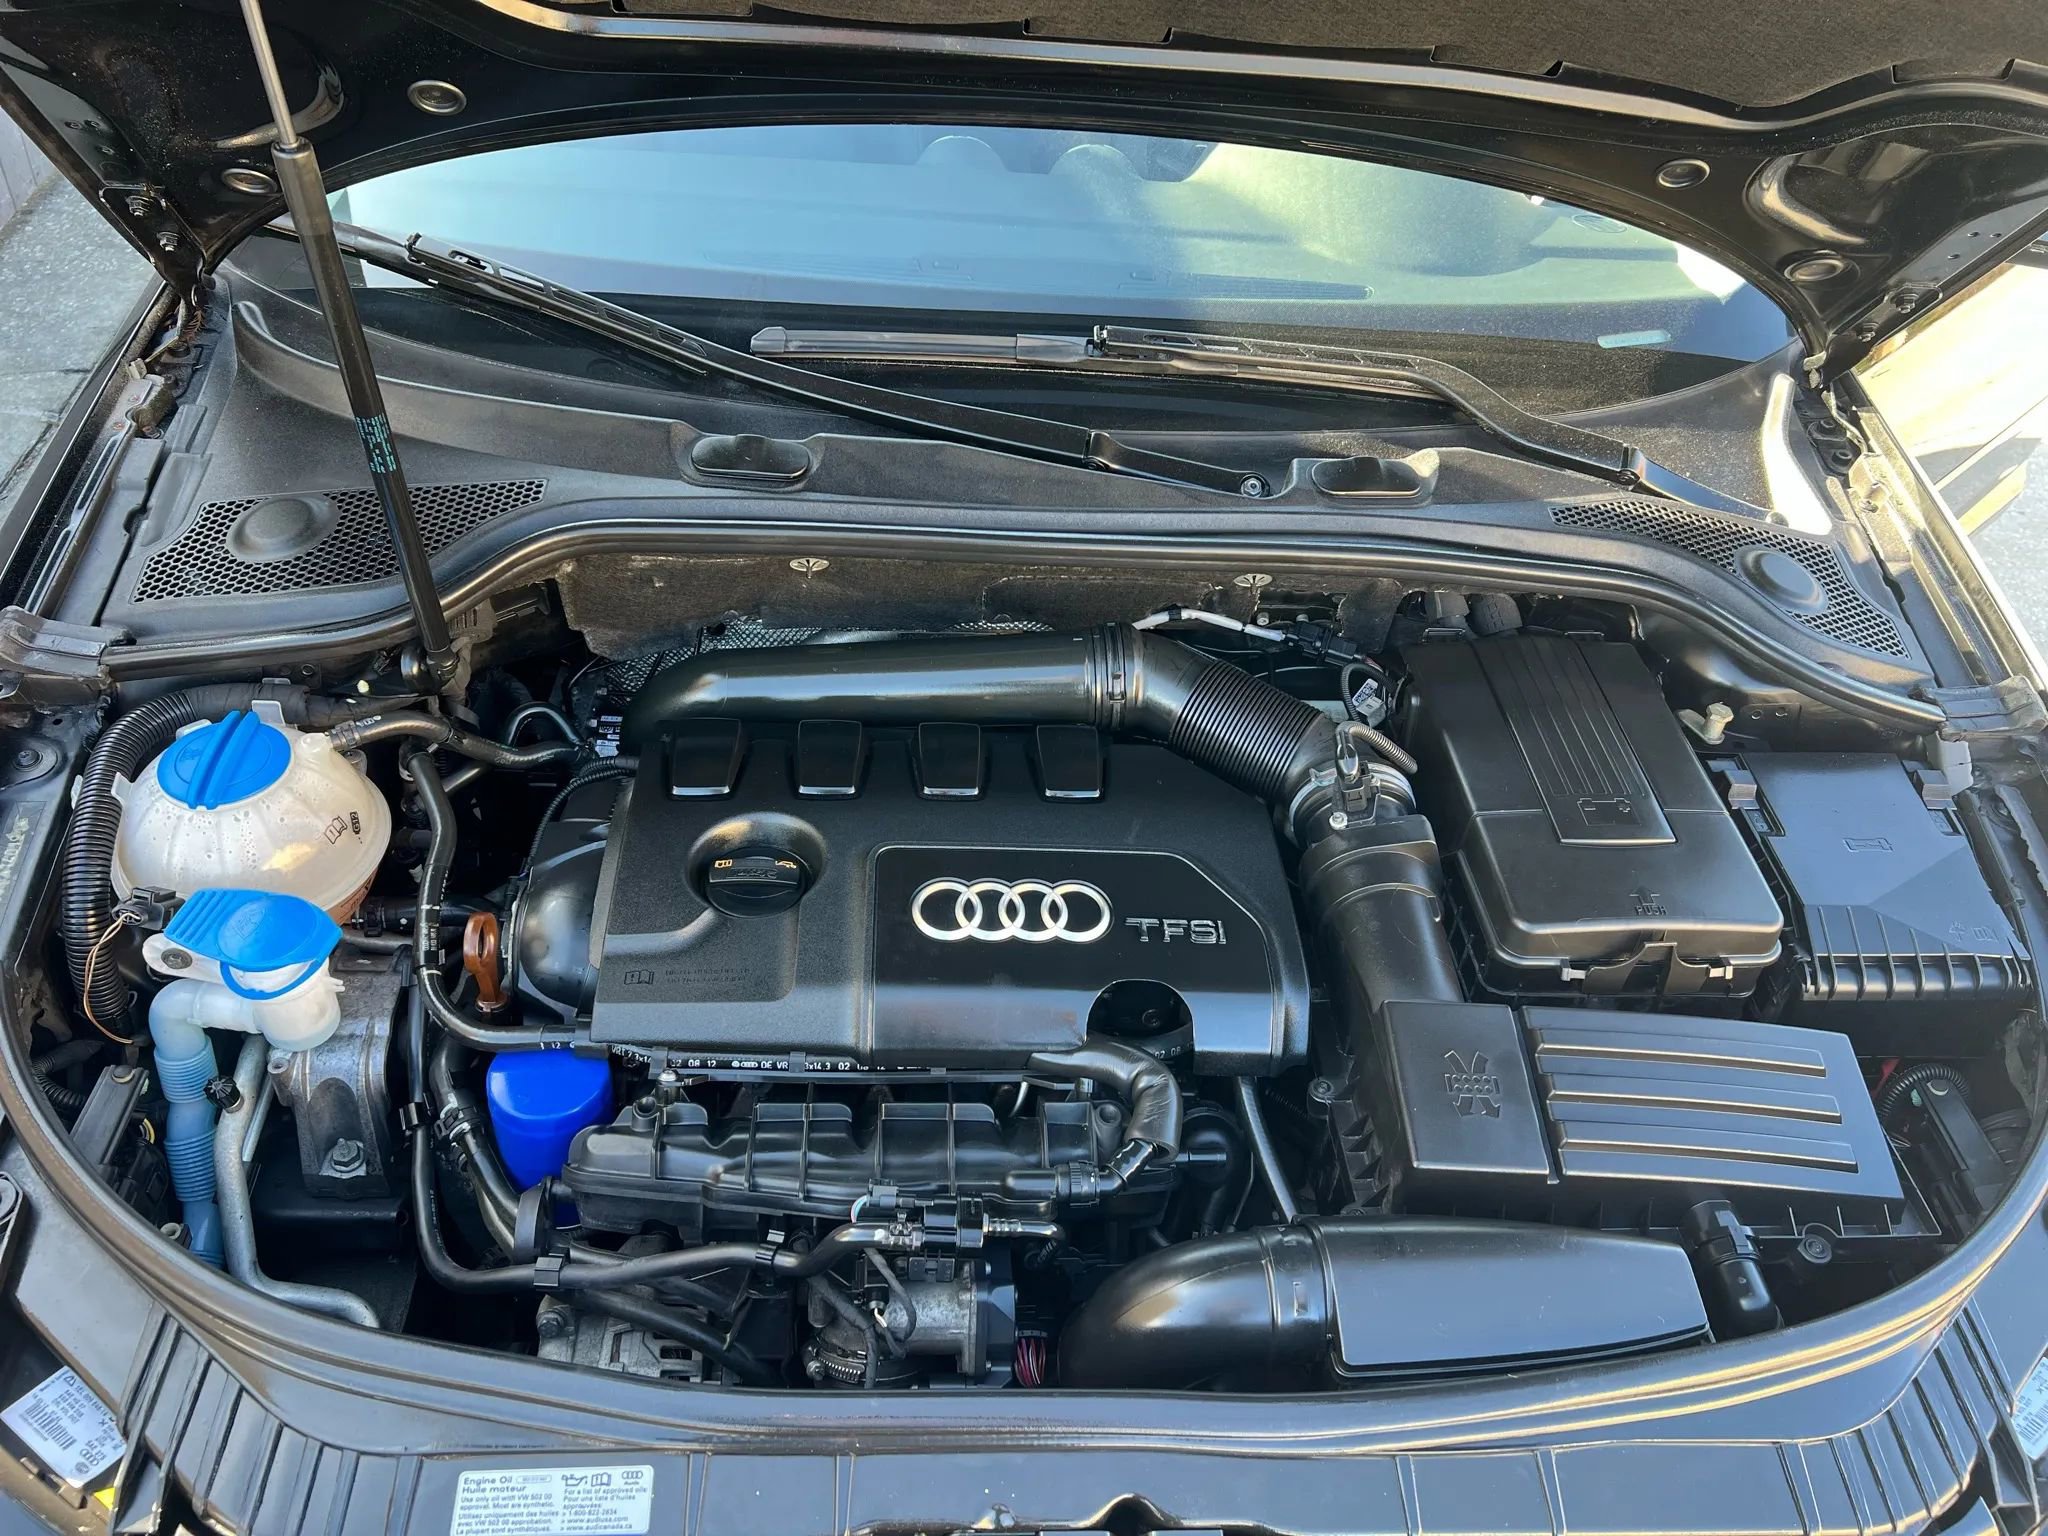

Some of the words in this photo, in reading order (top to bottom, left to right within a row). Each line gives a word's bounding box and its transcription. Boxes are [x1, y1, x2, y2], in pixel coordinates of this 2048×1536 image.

[1634, 905, 1667, 916] PUSH
[1124, 917, 1227, 945] TFSI
[706, 1060, 717, 1068] 12
[838, 1062, 850, 1070] 02
[463, 1477, 497, 1486] Engine
[499, 1476, 513, 1484] Oil
[462, 1486, 488, 1494] Huile
[489, 1485, 527, 1493] moteur
[602, 1487, 634, 1495] approved
[475, 1495, 489, 1503] only
[484, 1511, 524, 1519] uniquement
[466, 1527, 490, 1535] plupart
